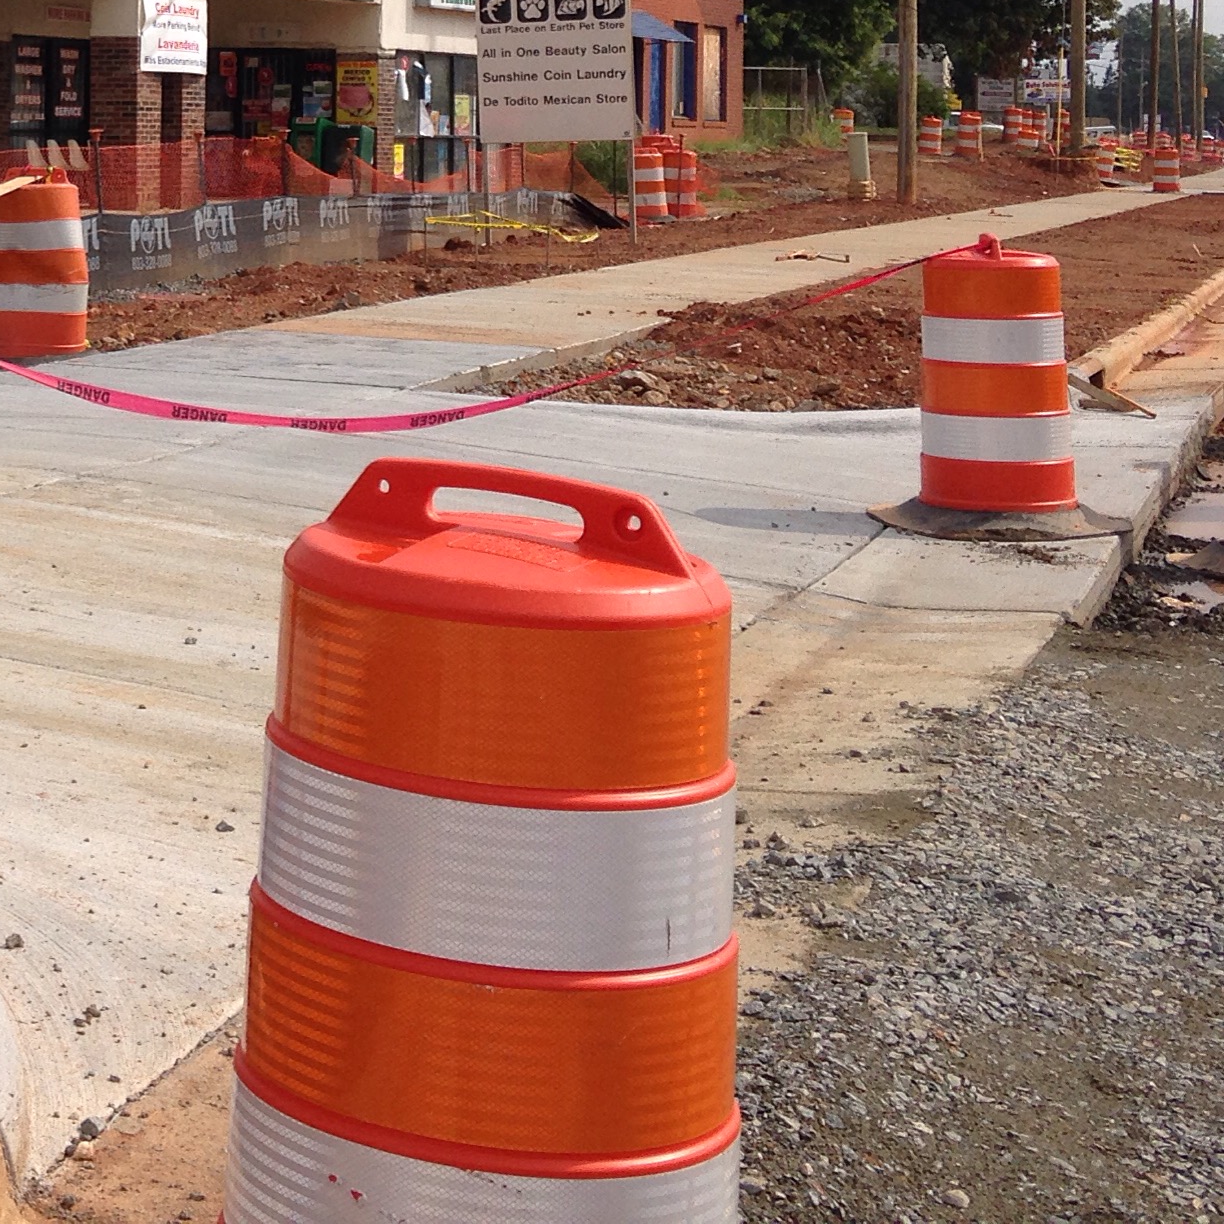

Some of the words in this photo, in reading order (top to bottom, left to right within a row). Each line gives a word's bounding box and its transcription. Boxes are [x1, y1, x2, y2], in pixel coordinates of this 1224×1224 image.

[173, 3, 199, 19] Laundry
[481, 26, 501, 35] Last
[505, 25, 530, 33] Place
[550, 23, 576, 32] Earth
[579, 22, 595, 30] Pet
[599, 21, 625, 30] Store
[157, 37, 199, 52] Lavanderia
[482, 49, 496, 58] All
[501, 48, 511, 57] in
[516, 47, 540, 57] One
[545, 46, 587, 56] Beauty
[592, 44, 626, 55] Salon
[482, 72, 538, 83] Sunshine
[543, 70, 572, 81] Coin
[577, 68, 626, 80] Laundry
[60, 91, 77, 101] FOLD
[483, 97, 499, 106] De
[504, 96, 538, 106] Todito
[543, 95, 591, 105] Mexican
[596, 93, 628, 103] Store
[172, 405, 228, 423] DANGER
[410, 409, 465, 428] DANGER
[290, 418, 347, 432] DANGER
